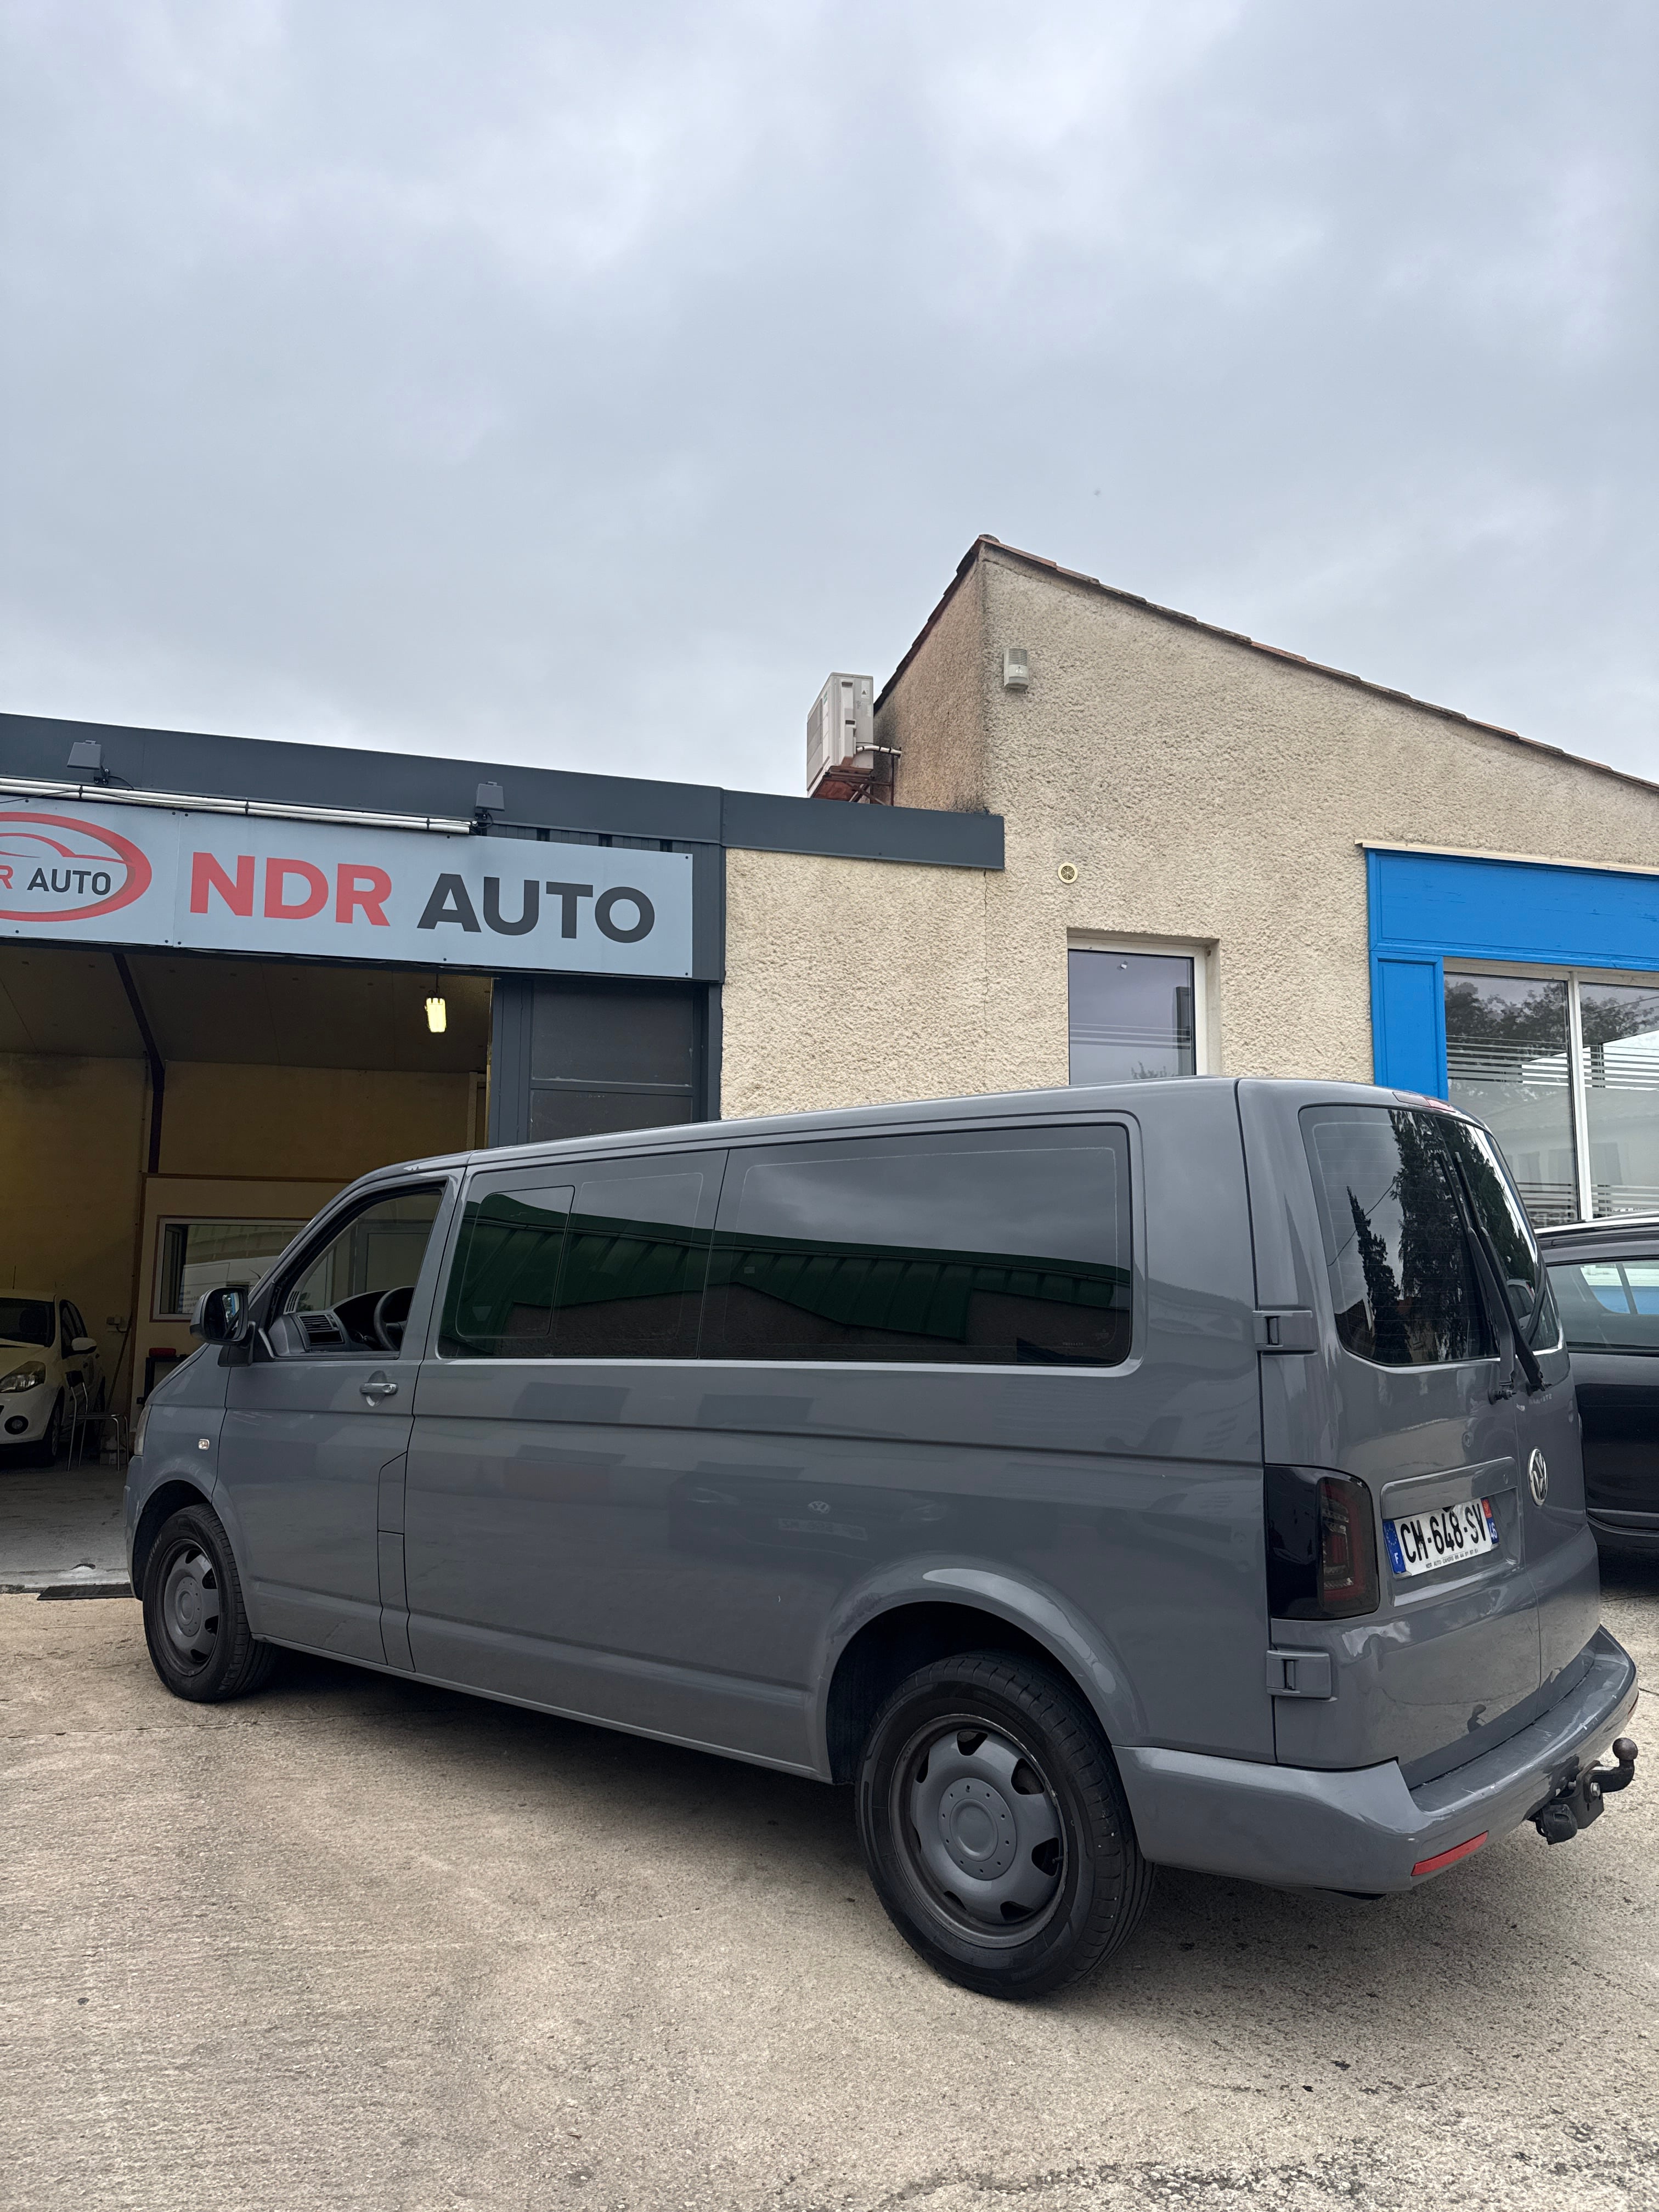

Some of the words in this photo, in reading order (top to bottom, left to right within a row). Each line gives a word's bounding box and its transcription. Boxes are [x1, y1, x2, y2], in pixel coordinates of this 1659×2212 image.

[27, 867, 111, 895] AUTO
[190, 852, 392, 927] NDR
[417, 873, 655, 944] AUTO
[1394, 1552, 1399, 1564] F
[1400, 1503, 1486, 1564] CH-648-SV
[1488, 1522, 1498, 1539] 46
